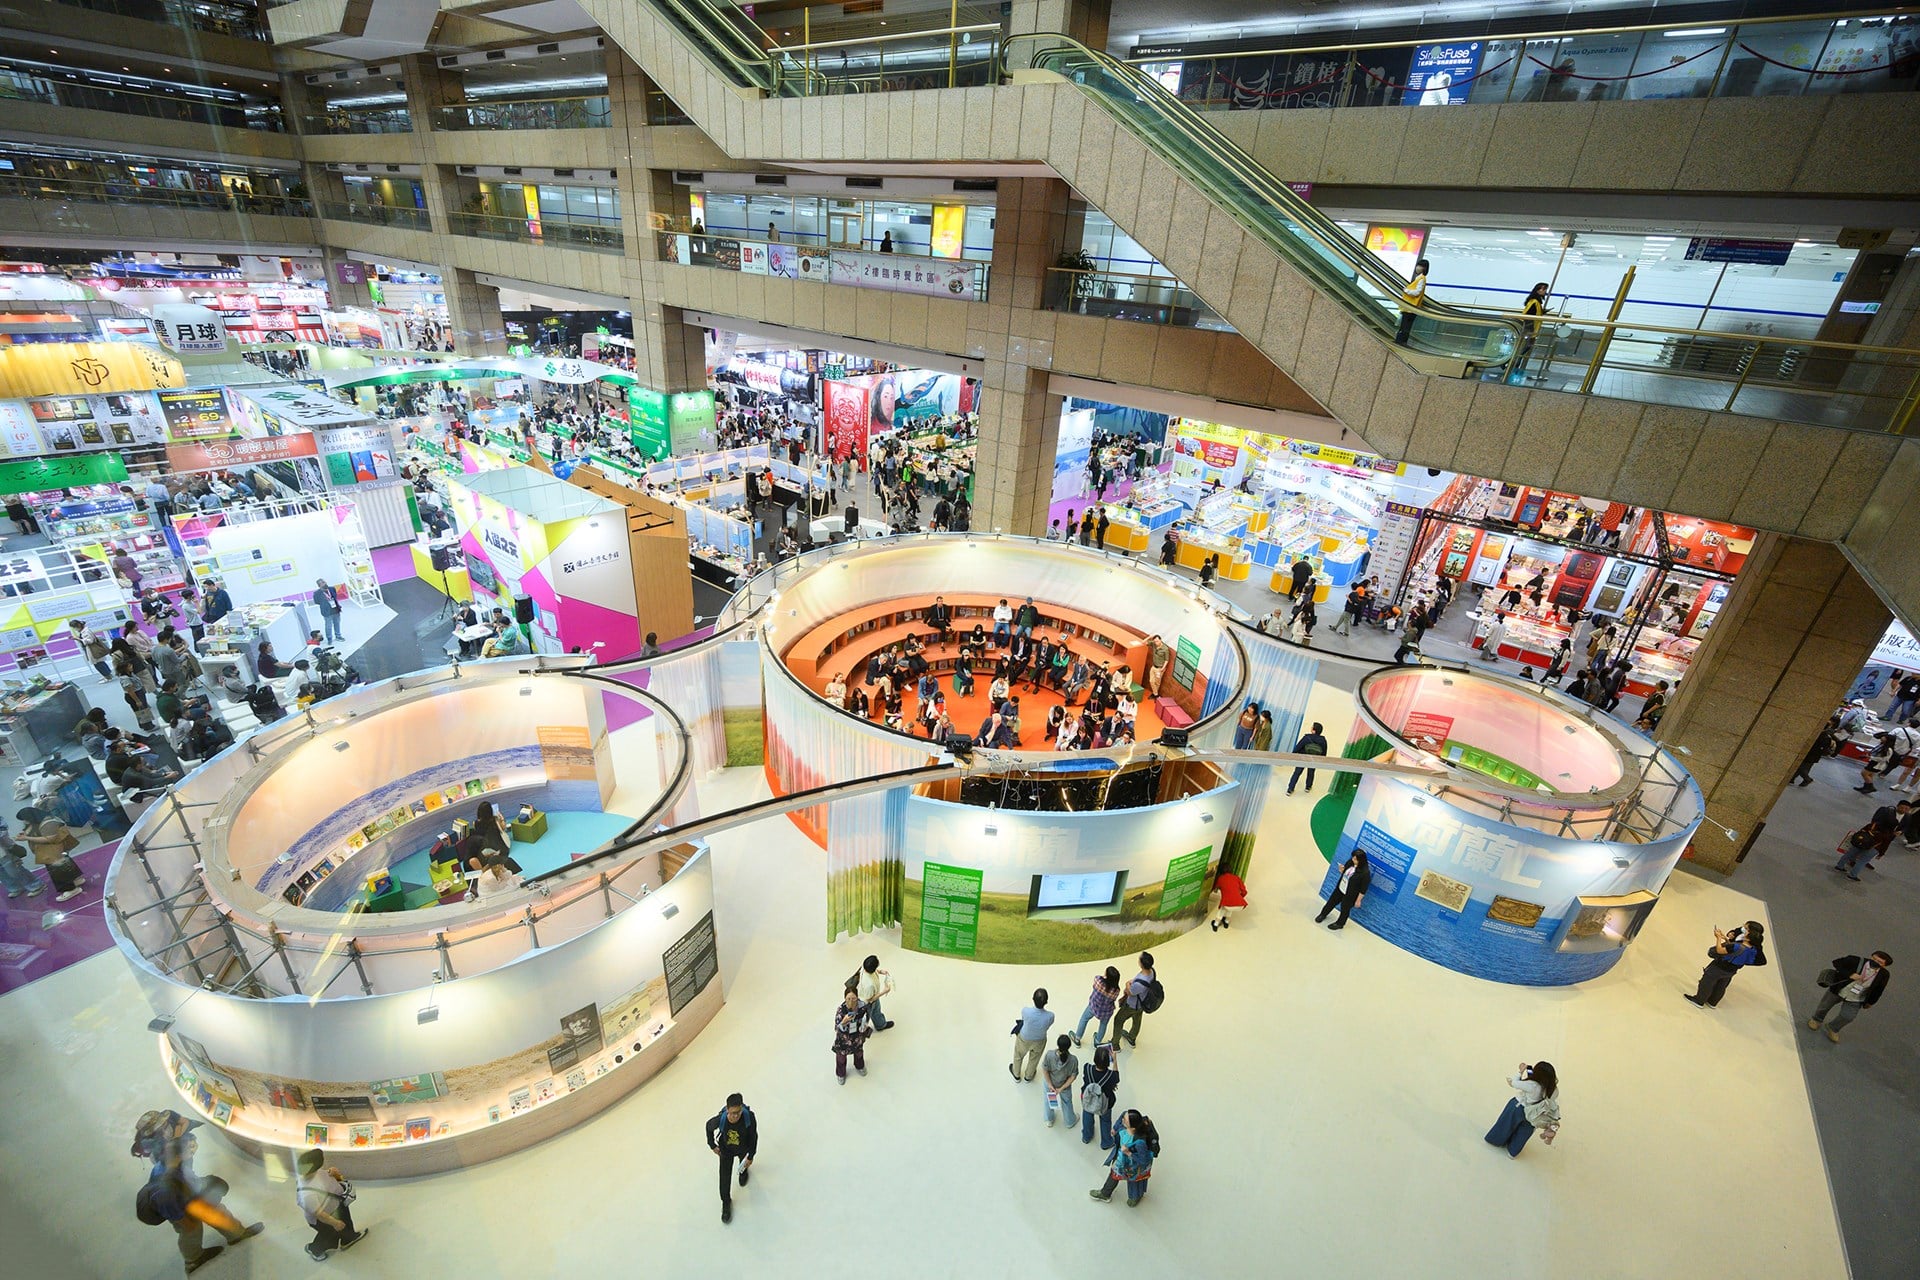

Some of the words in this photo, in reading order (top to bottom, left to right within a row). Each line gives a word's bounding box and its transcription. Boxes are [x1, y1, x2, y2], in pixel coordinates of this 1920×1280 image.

[864, 266, 935, 284] 2樓臨時餐飲區
[176, 323, 218, 340] 月球
[236, 440, 289, 454] 暖暖書屋
